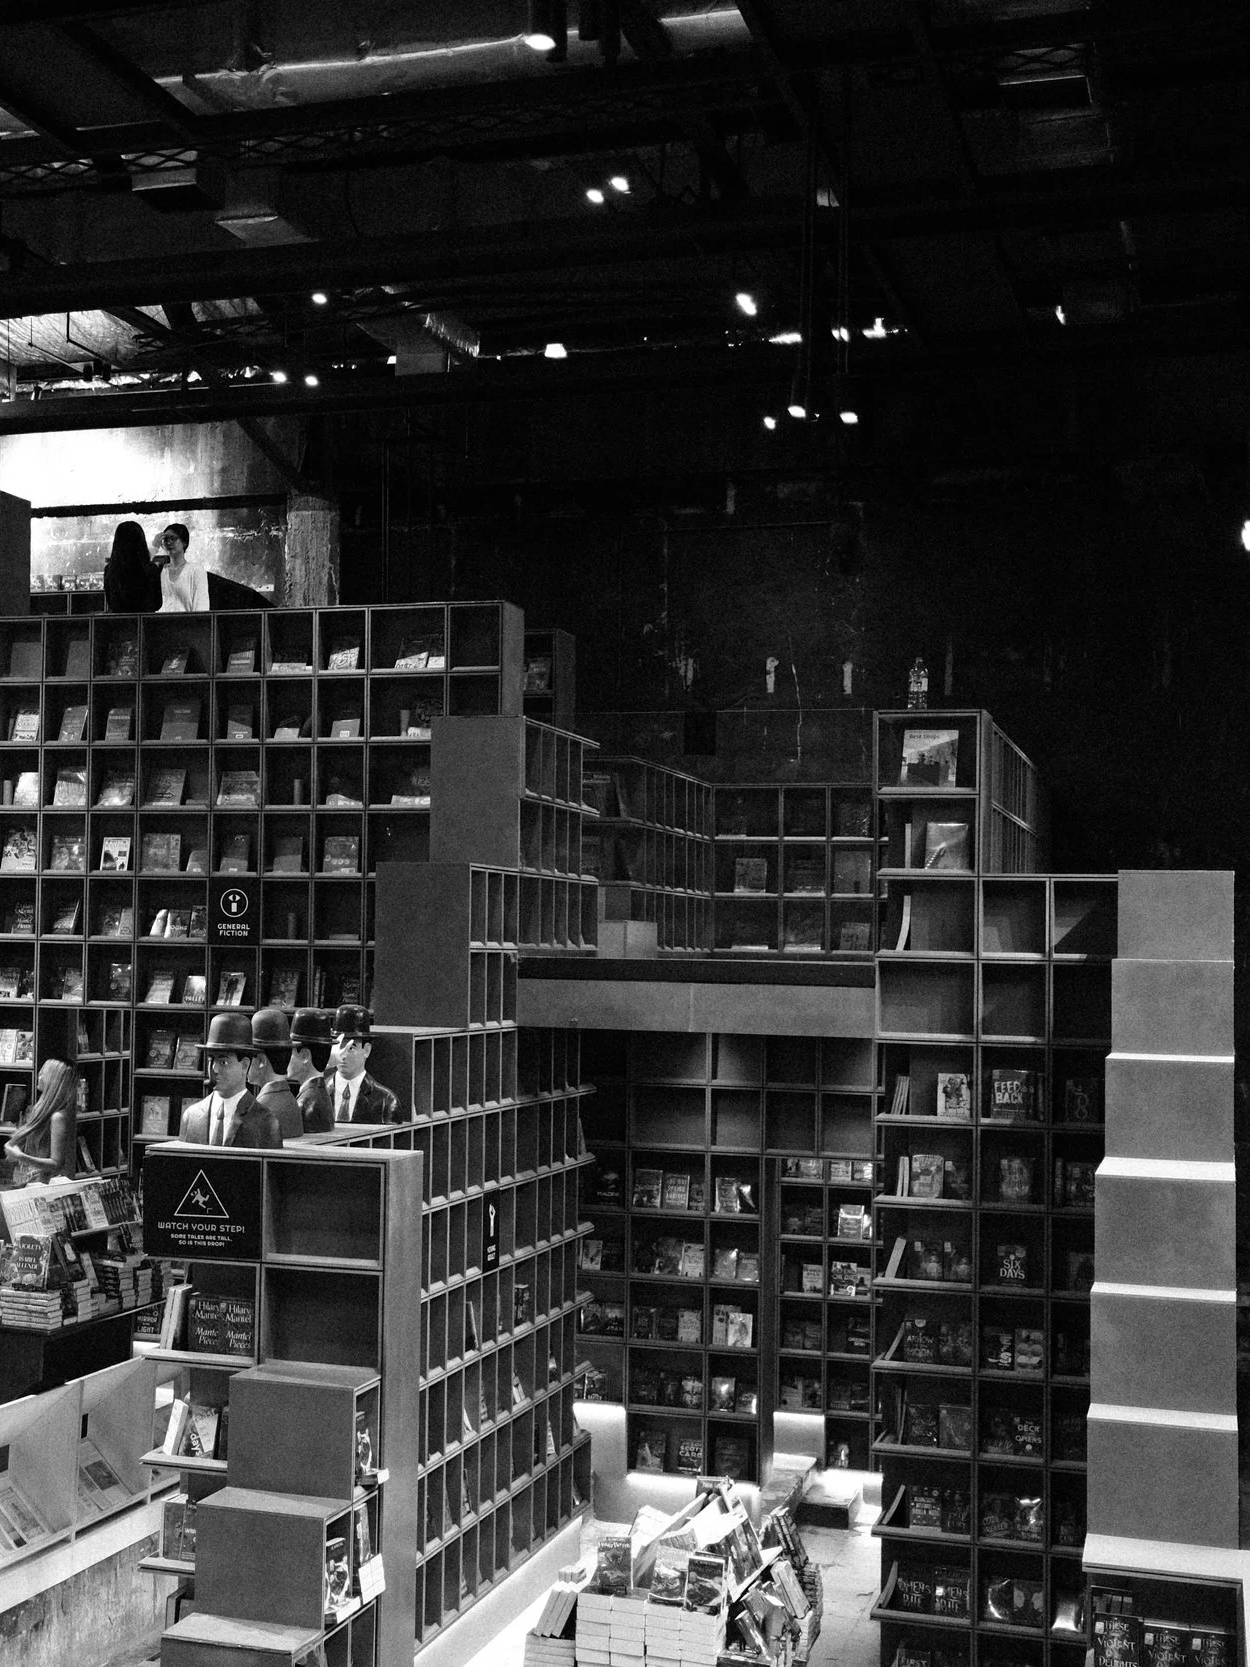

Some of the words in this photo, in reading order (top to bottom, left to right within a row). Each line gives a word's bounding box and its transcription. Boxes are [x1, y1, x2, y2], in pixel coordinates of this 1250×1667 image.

[217, 923, 251, 931] GENERAL
[219, 929, 249, 937] FICTION
[994, 1081, 1021, 1094] FEED
[995, 1092, 1023, 1104] BACK
[157, 1221, 189, 1231] WATCH
[191, 1223, 217, 1232] YOUR
[219, 1224, 245, 1233] STEP!
[1003, 1258, 1022, 1270] SIX
[1000, 1268, 1026, 1280] DAYS
[198, 1301, 220, 1312] Hilary
[229, 1304, 251, 1315] Hilary
[137, 1315, 158, 1323] MIRROR
[195, 1310, 218, 1320] Mante
[225, 1313, 252, 1323] Mantel
[137, 1325, 155, 1333] LIGHT
[195, 1327, 219, 1336] Mante
[225, 1330, 252, 1340] Mantel
[229, 1340, 251, 1349] Pieces
[1017, 1424, 1041, 1433] DECK
[1015, 1435, 1043, 1444] OMENS
